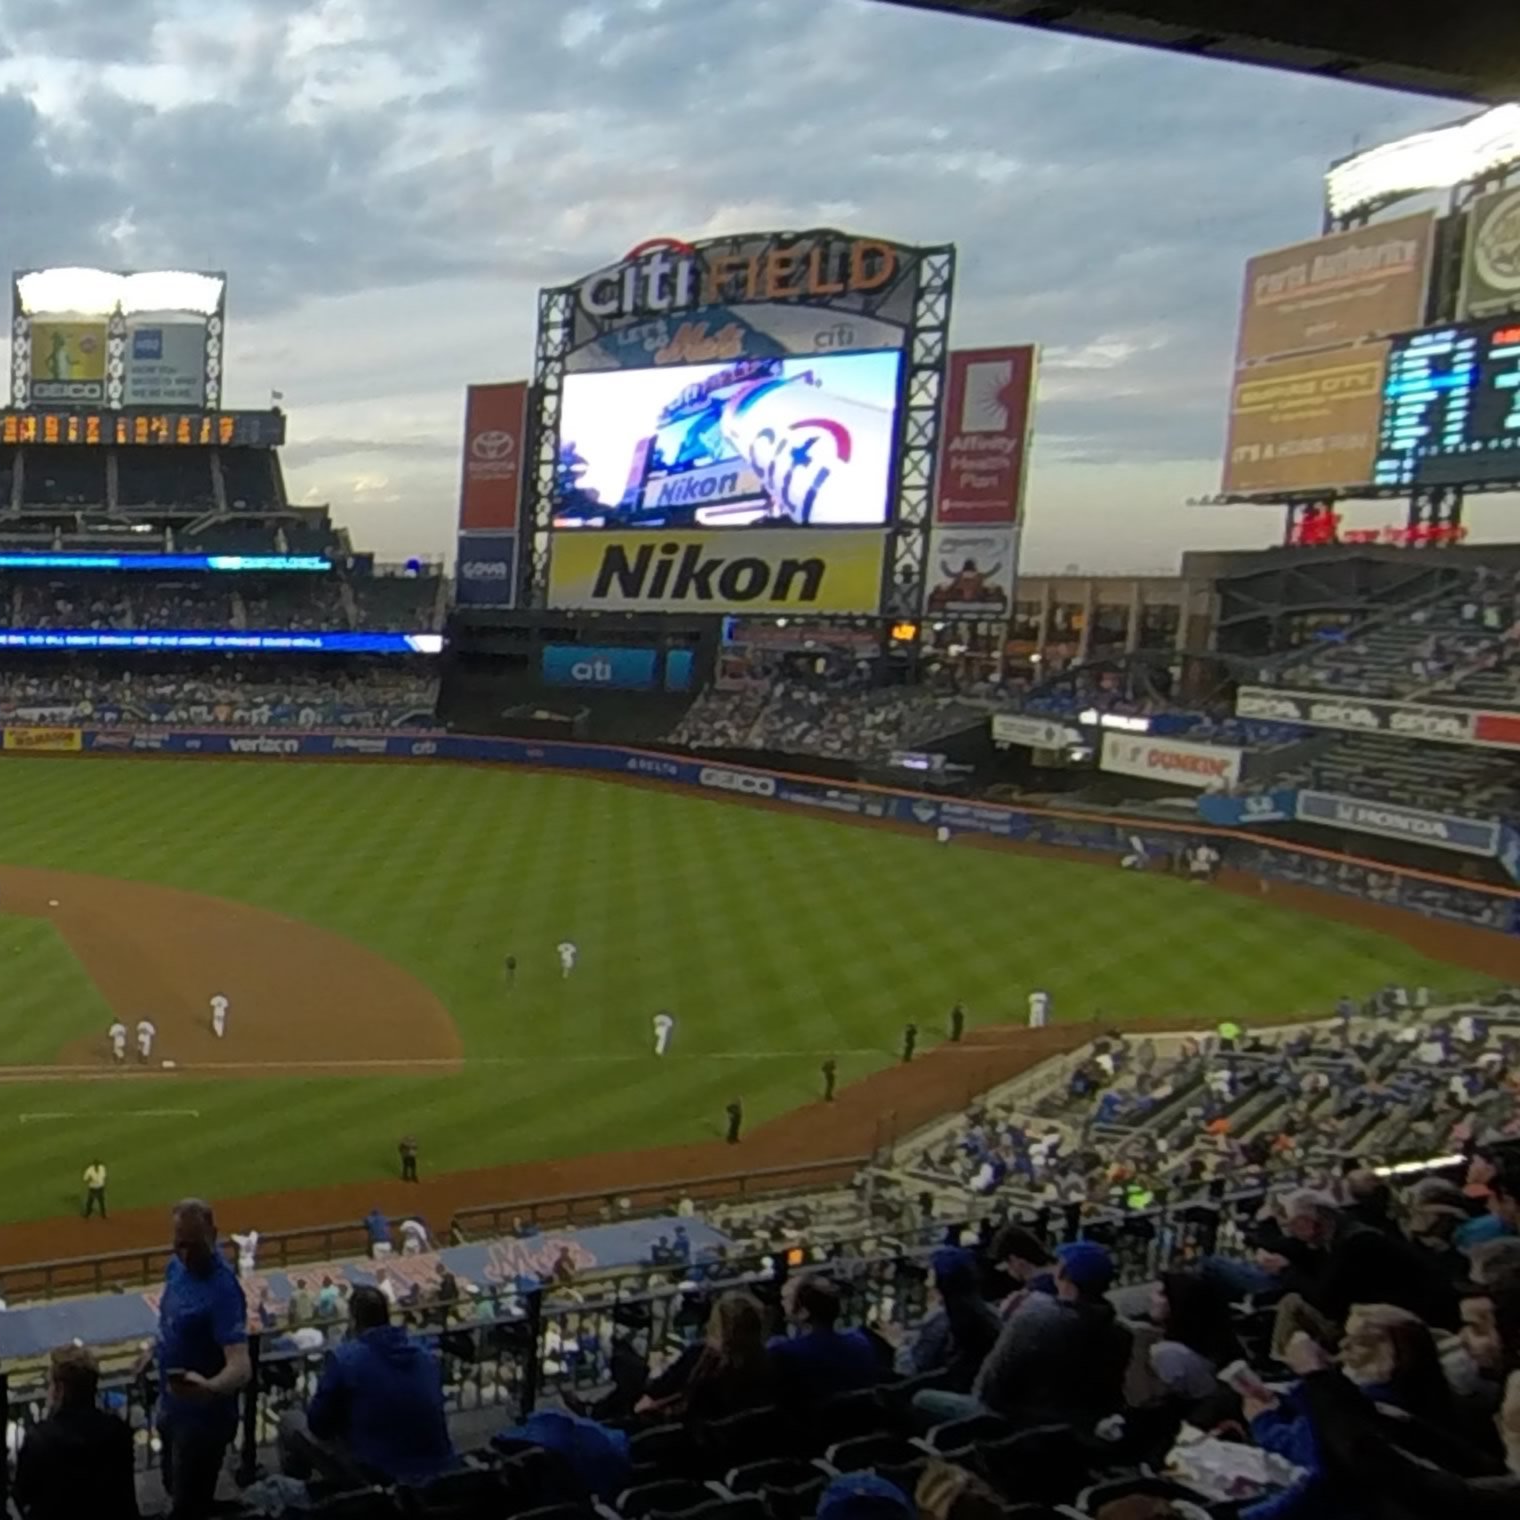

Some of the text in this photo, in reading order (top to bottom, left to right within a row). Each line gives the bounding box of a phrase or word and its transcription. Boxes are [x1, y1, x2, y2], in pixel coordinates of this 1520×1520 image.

[580, 241, 896, 317] citi FIELD
[814, 323, 856, 347] citi
[948, 437, 1018, 456] Affinity
[951, 455, 1011, 471] Health
[659, 470, 738, 506] Nikon
[960, 472, 999, 489] Plan
[592, 543, 826, 602] Nikon
[571, 661, 611, 681] citi
[230, 735, 298, 752] verizon
[700, 768, 775, 795] GEICO
[1358, 810, 1448, 838] HONDA
